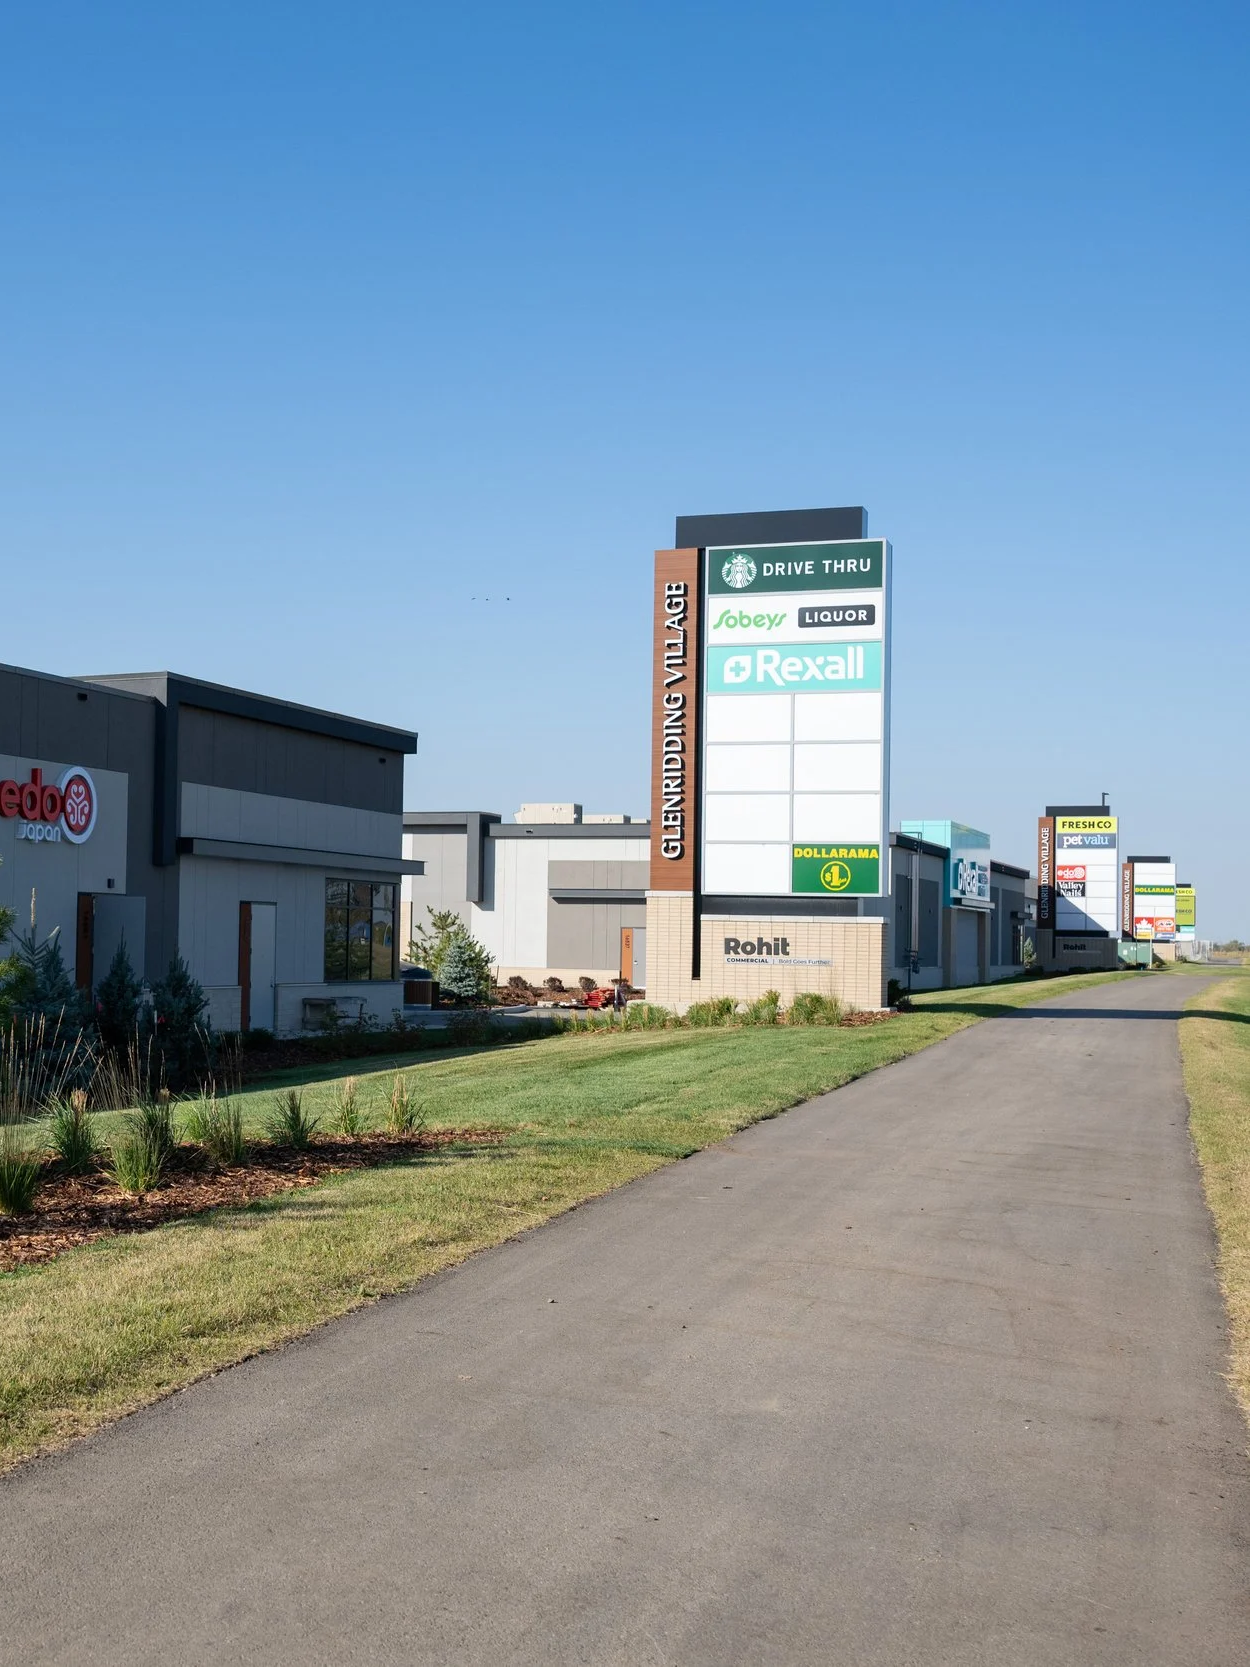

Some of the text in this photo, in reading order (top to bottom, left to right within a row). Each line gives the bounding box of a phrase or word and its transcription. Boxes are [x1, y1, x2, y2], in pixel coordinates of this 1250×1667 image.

[763, 558, 871, 576] DRIVE THRU
[713, 609, 868, 631] Sobeys LIQUOR
[756, 646, 864, 687] Rexall
[661, 581, 686, 860] GLENRIDDING VILLAGE
[17, 820, 61, 843] japan
[1063, 834, 1109, 848] pet valu
[793, 847, 879, 859] DOLLARAMA
[1040, 827, 1050, 919] GLENRIDDING VILLAGE
[1058, 881, 1083, 891] Valley
[724, 937, 790, 956] Rohit
